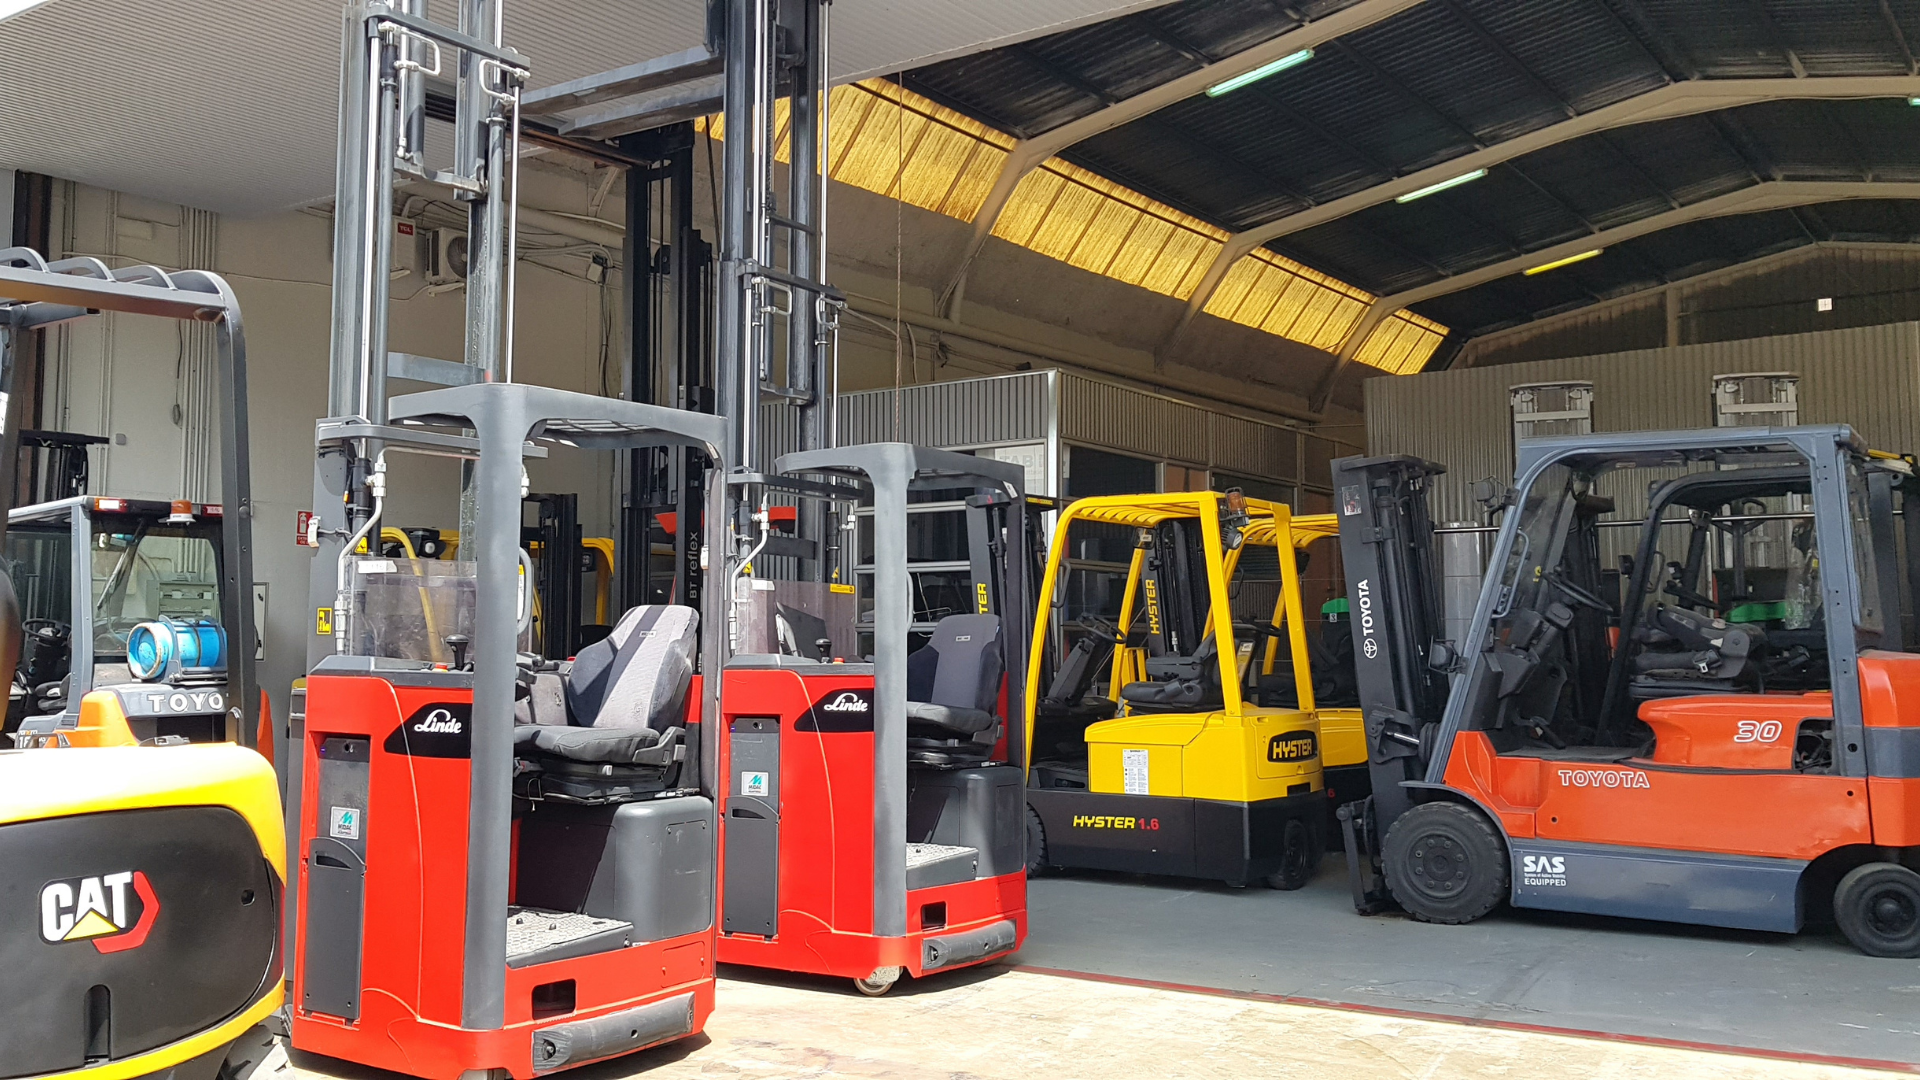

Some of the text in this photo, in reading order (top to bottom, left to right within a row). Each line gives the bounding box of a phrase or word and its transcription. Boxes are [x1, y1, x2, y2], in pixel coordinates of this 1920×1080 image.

[687, 531, 698, 599] BT reflex
[1145, 579, 1160, 635] HYSTER
[1357, 579, 1374, 637] TOYOTA
[147, 691, 229, 713] TOYO
[823, 692, 869, 712] Linde
[413, 708, 462, 734] Linde
[1733, 720, 1783, 743] 30
[1272, 738, 1312, 759] HYSTER
[1558, 769, 1650, 789] TOYOTA
[1073, 815, 1160, 830] HYSTER 1.6
[1523, 855, 1566, 873] SAS
[1524, 878, 1567, 886] EQUIPPED
[41, 871, 132, 941] CAT
